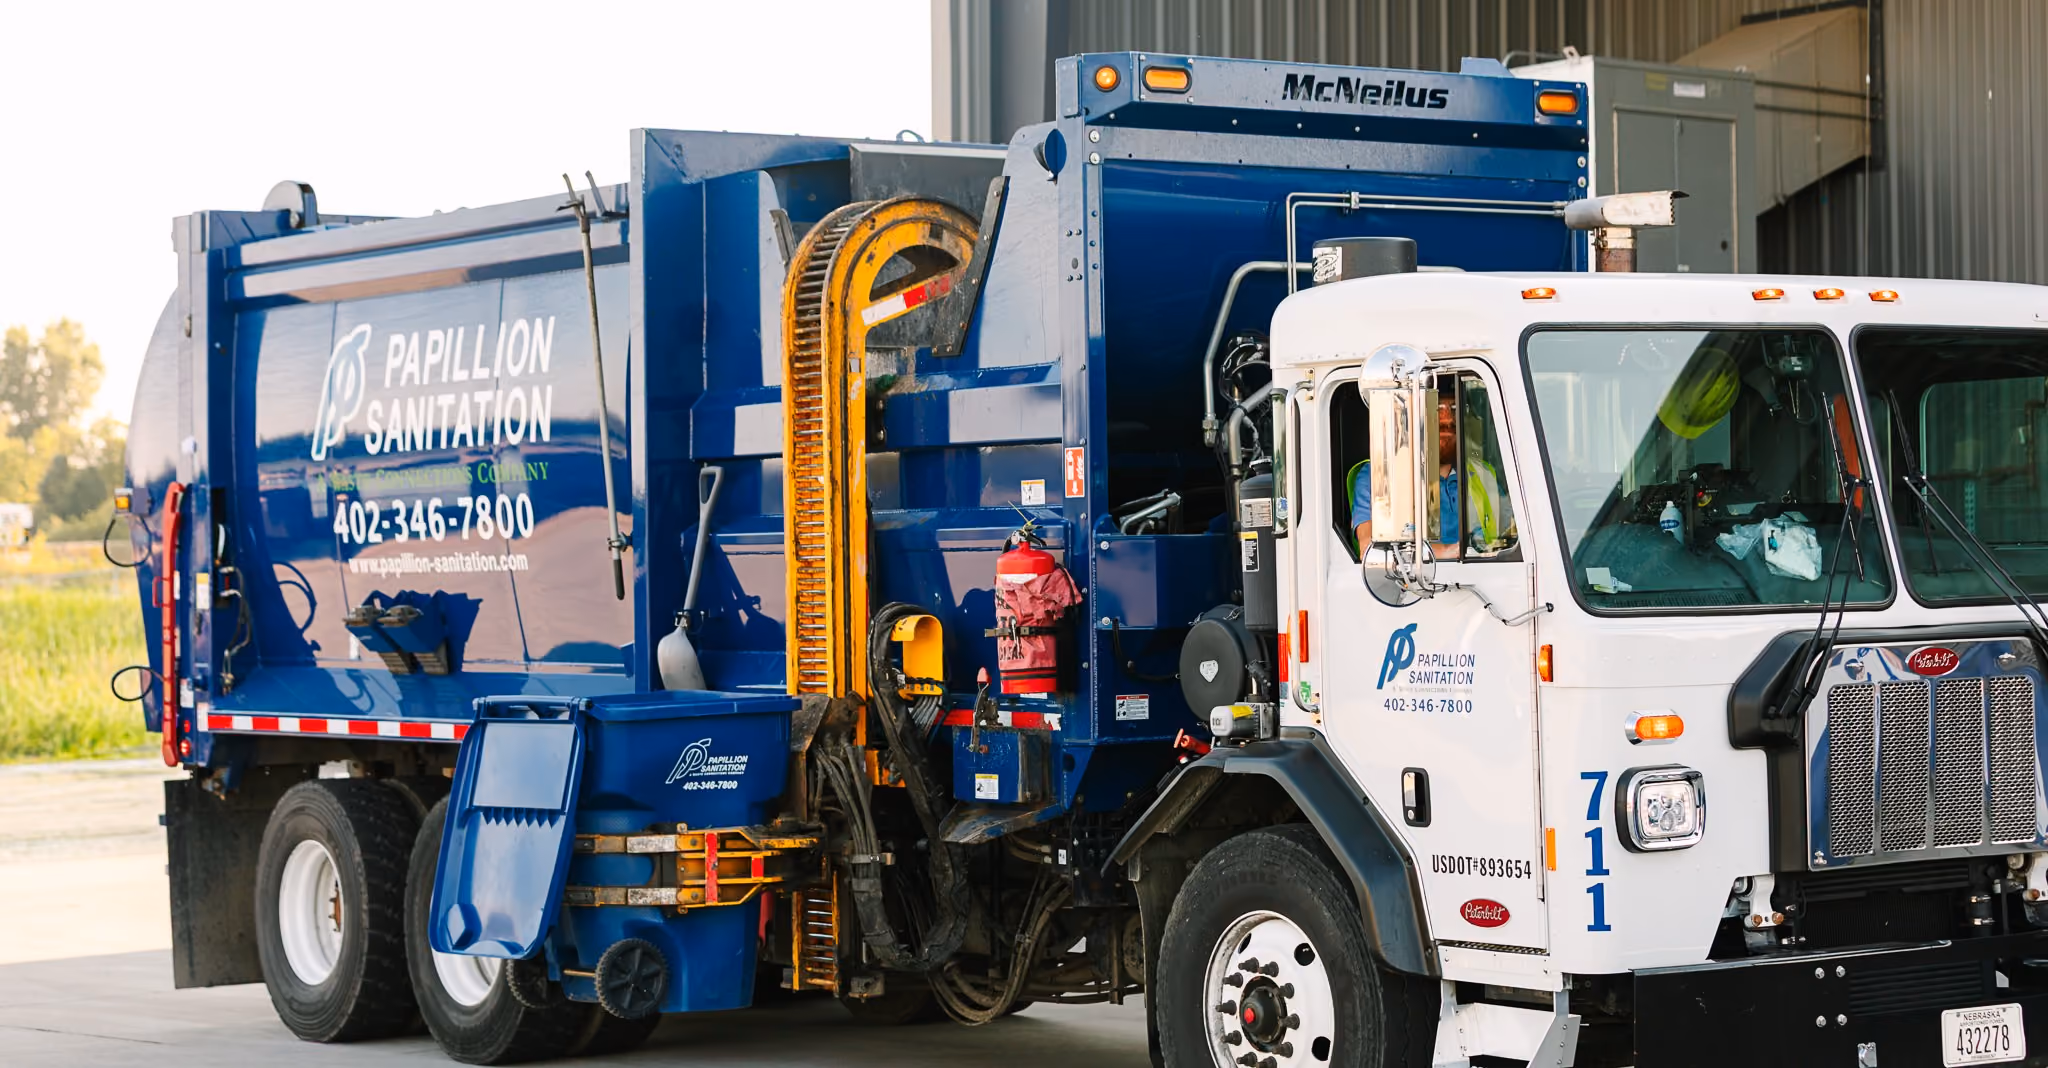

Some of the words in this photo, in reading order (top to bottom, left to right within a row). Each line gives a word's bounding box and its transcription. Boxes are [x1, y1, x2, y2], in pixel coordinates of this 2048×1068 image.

[1282, 73, 1449, 109] McNeilus
[384, 316, 555, 388] PAPILLION
[364, 385, 552, 455] SANITATION
[333, 493, 534, 544] 402-346-7800
[348, 551, 528, 578] www.papillion-sanitation.com
[1417, 653, 1475, 668] PAPILLION
[1914, 652, 1954, 670] Peterbilt
[1409, 670, 1474, 685] SANITATION
[1383, 698, 1473, 714] 402-346-7800
[701, 763, 746, 772] SANITATION
[708, 755, 748, 764] PAPILLION
[683, 780, 738, 790] 402-346-7800
[1432, 853, 1532, 880] USDOT#893654
[1464, 902, 1506, 922] Peterbilt
[1963, 1010, 2001, 1021] NEBRASKA
[1956, 1024, 2010, 1056] 432278
